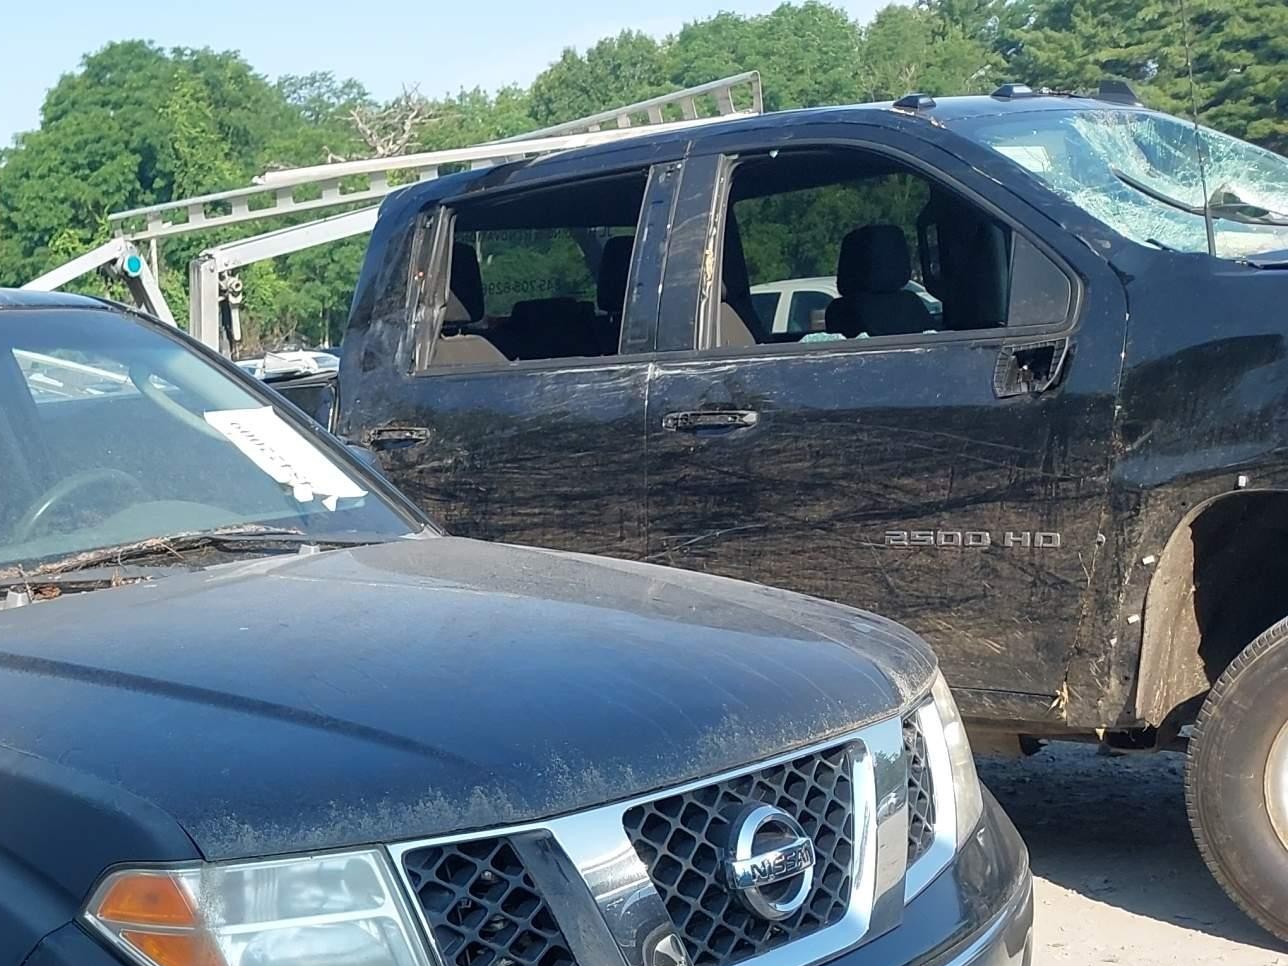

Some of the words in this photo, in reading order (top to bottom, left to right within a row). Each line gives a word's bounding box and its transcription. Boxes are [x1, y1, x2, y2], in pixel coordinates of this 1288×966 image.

[885, 531, 991, 546] 2500
[1004, 531, 1061, 547] HD
[750, 844, 811, 882] NISSAN
